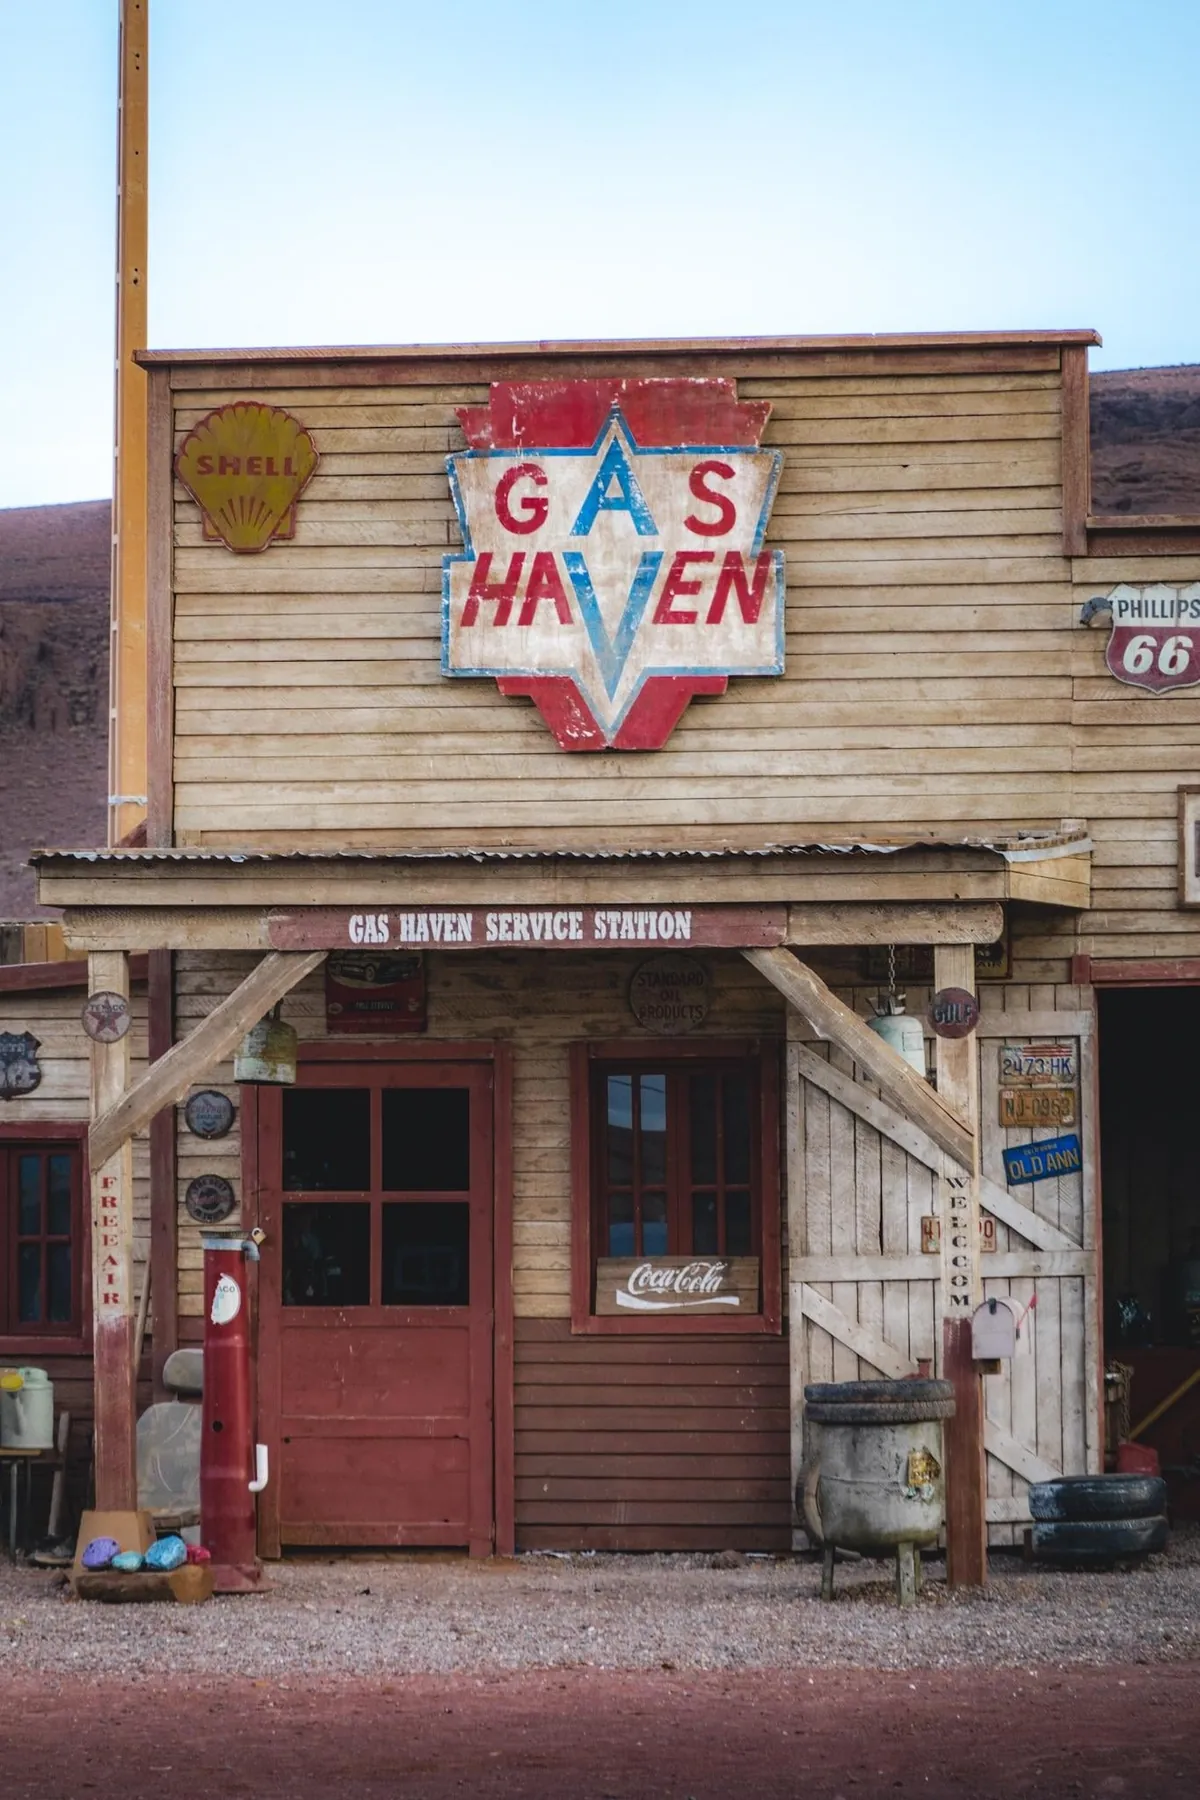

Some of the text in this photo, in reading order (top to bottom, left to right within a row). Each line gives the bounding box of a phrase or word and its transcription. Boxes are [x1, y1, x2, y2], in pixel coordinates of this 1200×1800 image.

[197, 455, 297, 476] SHELL
[495, 434, 736, 536] GAS
[1118, 599, 1200, 619] PHILLIPS
[460, 551, 771, 702] HAVEN
[1123, 634, 1193, 676] 66
[349, 911, 691, 943] GAS HAVEN SERVICE STATION
[639, 1004, 703, 1019] PRODUCTS
[660, 989, 682, 1002] OIL
[1009, 1148, 1080, 1180] OLD ANN
